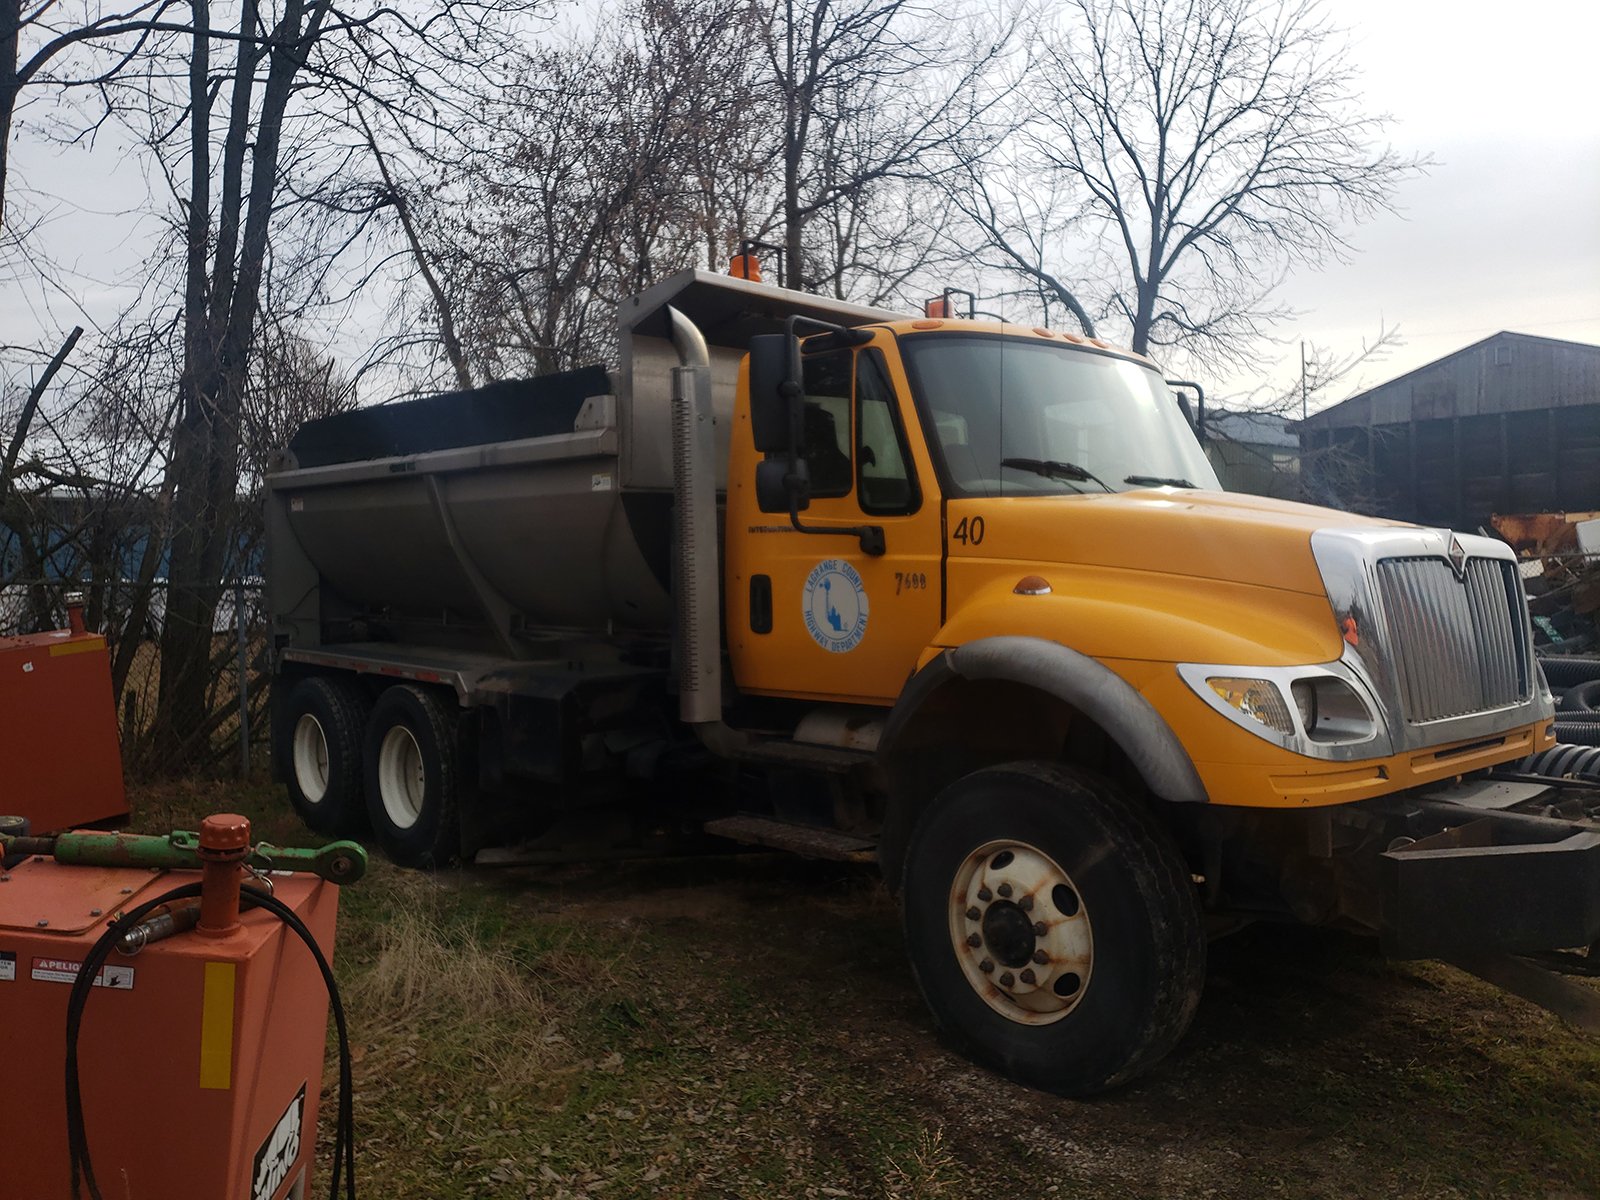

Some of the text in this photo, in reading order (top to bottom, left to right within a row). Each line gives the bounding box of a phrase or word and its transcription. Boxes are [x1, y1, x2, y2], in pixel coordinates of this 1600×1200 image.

[953, 516, 984, 545] 40
[806, 560, 864, 593] LAGRANGE COUNTY
[805, 610, 867, 652] HIGHWAY DEPARTMENT
